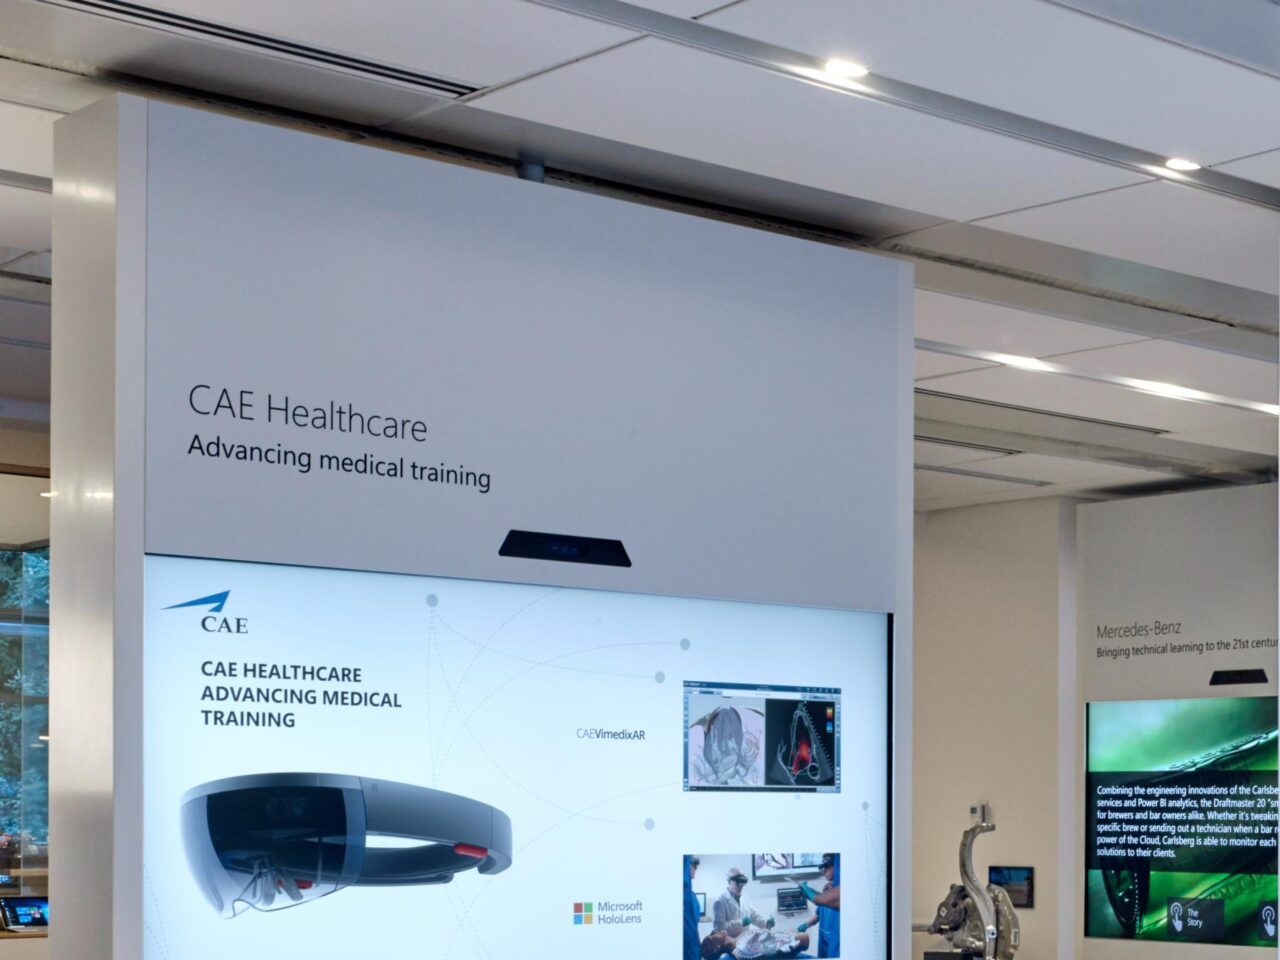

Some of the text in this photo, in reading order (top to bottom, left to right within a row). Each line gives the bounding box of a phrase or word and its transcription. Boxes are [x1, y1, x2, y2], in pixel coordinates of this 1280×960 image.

[188, 384, 429, 443] CAE Healthcare
[187, 434, 492, 494] Advancing medical training
[200, 615, 249, 635] CAE
[1096, 620, 1182, 639] Mercedes-Benz
[1096, 646, 1131, 660] Bringing
[1132, 643, 1168, 656] technical
[1169, 641, 1204, 655] learning
[1205, 641, 1215, 651] to
[1216, 639, 1231, 650] the
[1232, 638, 1249, 650] 21st
[200, 660, 363, 683] CAE HEALTHCARE
[200, 685, 402, 708] ADVANCING MEDICAL
[200, 709, 296, 728] TRAINING
[1096, 785, 1133, 797] Combining
[1134, 785, 1145, 795] the
[1146, 785, 1187, 797] engineering
[1188, 785, 1228, 795] innovations
[1229, 785, 1238, 795] of
[1239, 785, 1250, 795] the
[1096, 798, 1122, 807] services
[1123, 798, 1136, 807] and
[1138, 798, 1158, 807] Power
[1159, 798, 1167, 807] BI
[1168, 798, 1199, 810] analytics,
[1200, 798, 1212, 807] the
[1213, 798, 1255, 808] Draftmaster
[1256, 799, 1266, 808] 20
[1096, 810, 1107, 819] for
[1107, 810, 1134, 820] brewers
[1135, 810, 1148, 820] and
[1149, 810, 1160, 820] bar
[1162, 812, 1186, 820] owners
[1188, 810, 1206, 820] alike.
[1207, 810, 1237, 820] Whether
[1096, 822, 1121, 834] specific
[1122, 822, 1139, 832] brew
[1149, 823, 1176, 835] sending
[1177, 824, 1190, 832] out
[1190, 825, 1196, 833] a
[1196, 823, 1232, 833] technician
[1233, 823, 1253, 833] when
[1260, 824, 1273, 834] bar
[1096, 835, 1277, 848] power of the Cloud, Carlsberg is able to monitor each
[1096, 847, 1177, 858] solutions to their clients.
[597, 900, 643, 913] Microsoft
[1187, 908, 1199, 917] The
[597, 912, 642, 925] HoloLens
[1187, 918, 1203, 928] Story
